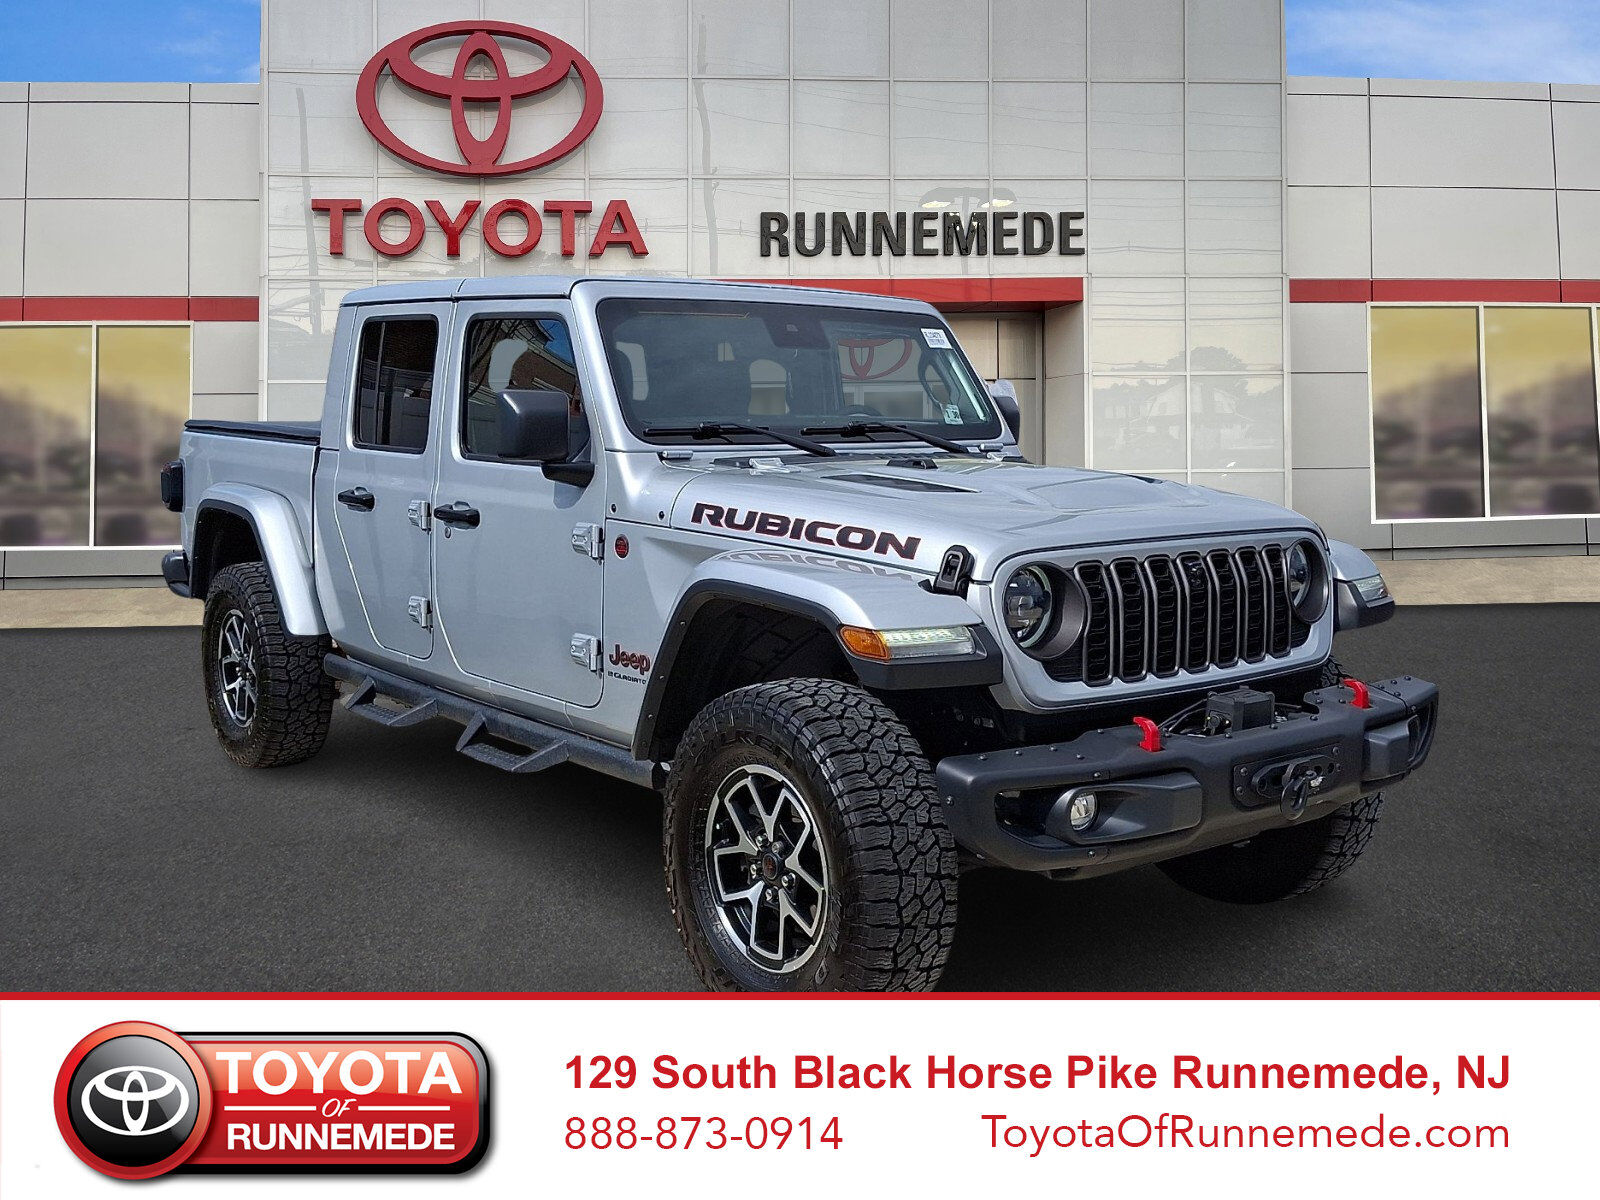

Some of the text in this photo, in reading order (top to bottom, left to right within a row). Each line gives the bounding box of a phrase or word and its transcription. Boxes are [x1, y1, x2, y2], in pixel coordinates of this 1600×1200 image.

[312, 198, 648, 257] TOYOTA
[760, 212, 1085, 257] RUNNEMEDE
[690, 502, 921, 560] RUBICON
[609, 644, 651, 675] Jeep
